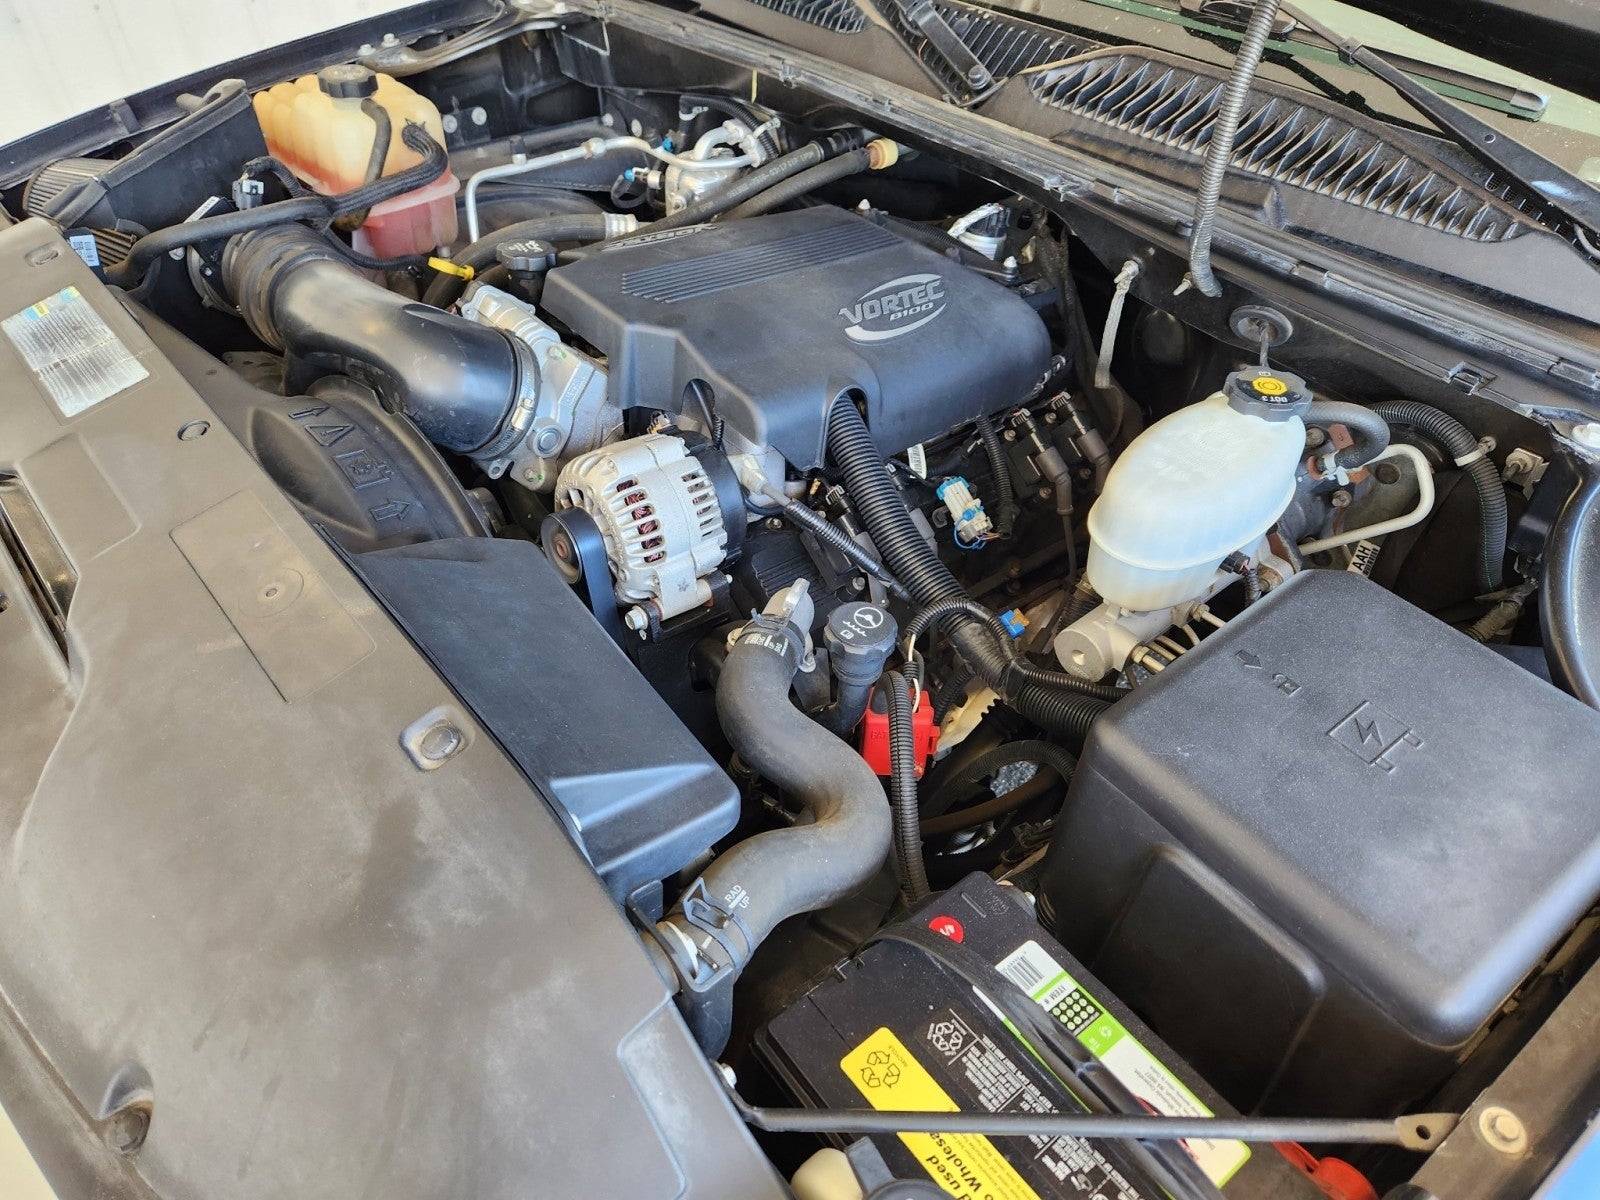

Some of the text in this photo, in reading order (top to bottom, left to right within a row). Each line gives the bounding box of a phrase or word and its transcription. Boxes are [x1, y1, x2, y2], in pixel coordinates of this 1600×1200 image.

[838, 280, 945, 325] VORTEC
[1269, 395, 1287, 403] DOT
[1351, 544, 1371, 570] AAH
[723, 883, 743, 903] RAD
[738, 895, 752, 910] UP
[1048, 983, 1066, 1001] ITEM
[887, 1043, 909, 1067] RECYCLE
[993, 1047, 1006, 1060] AND
[1002, 1056, 1018, 1073] TIGHT
[1014, 1069, 1030, 1085] CAPS
[929, 1131, 982, 1193] Wholesa
[926, 1154, 961, 1191] used
